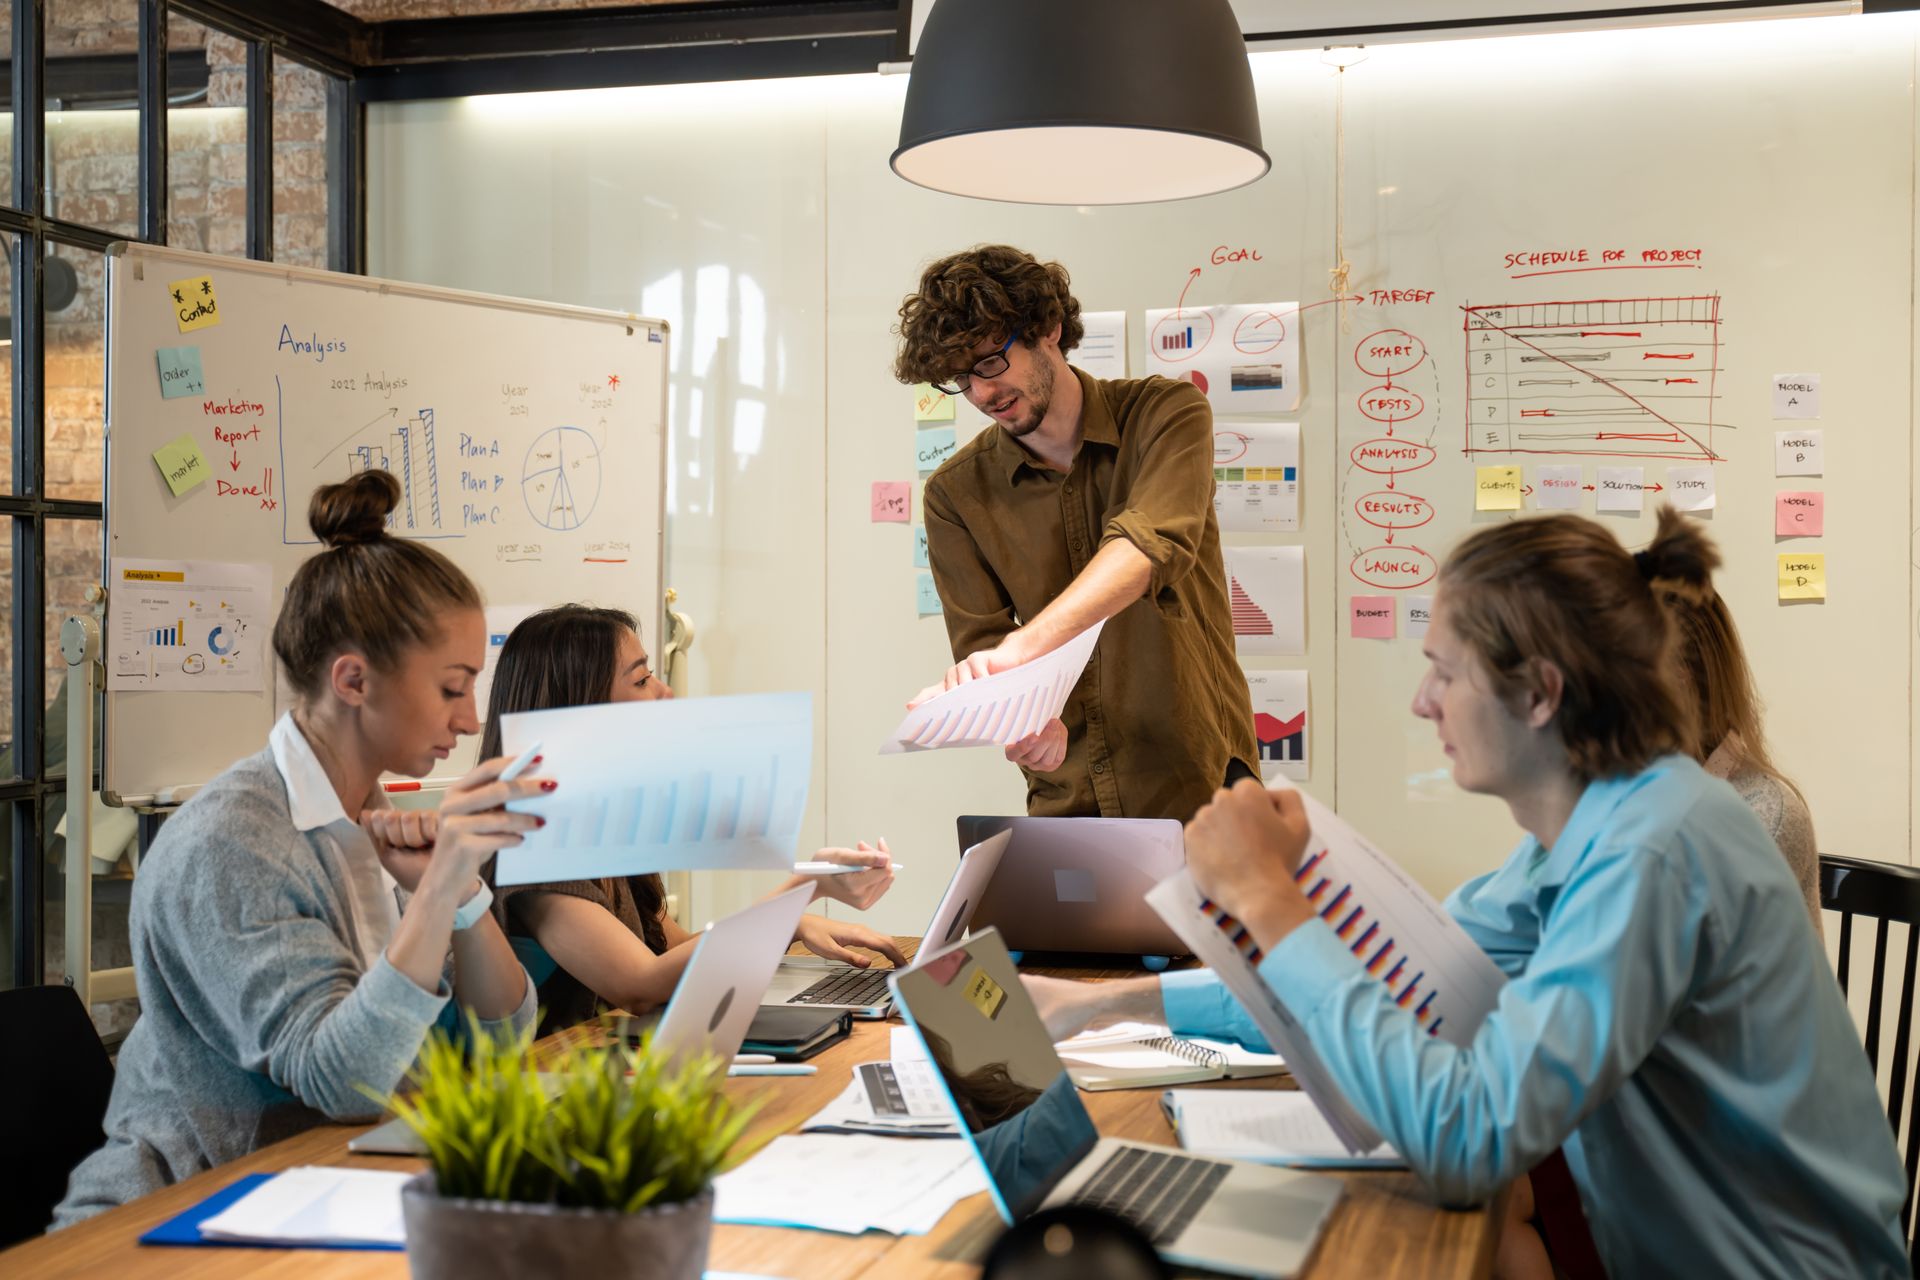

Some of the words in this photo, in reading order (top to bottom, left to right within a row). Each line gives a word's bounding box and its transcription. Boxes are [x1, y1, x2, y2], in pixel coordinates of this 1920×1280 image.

[1210, 245, 1263, 265] GOAL
[1504, 249, 1589, 269] SCHEDULE
[1602, 249, 1626, 263] FOR
[1369, 289, 1435, 305] TARGET
[180, 299, 216, 322] Contact
[278, 324, 347, 362] Analysis
[1482, 332, 1491, 344] A
[1370, 346, 1412, 358] START
[330, 378, 356, 391] 2022
[364, 370, 408, 400] Analysis
[1485, 377, 1496, 389] C
[1778, 383, 1814, 392] MODEL
[203, 398, 265, 417] Marketing
[1366, 399, 1412, 411] TESTS
[1787, 397, 1798, 407] A
[214, 424, 261, 447] Report
[459, 432, 487, 457] Plan
[489, 439, 500, 457] A
[1782, 439, 1816, 448] MODEL
[1359, 447, 1419, 460] ANALYSIS
[1796, 452, 1806, 463] B
[461, 472, 487, 492] Plan
[1480, 481, 1516, 490] CLIENTS
[1542, 480, 1578, 488] DESIGN
[1602, 479, 1644, 490] SOLUTION
[1364, 500, 1422, 515] RESULTS
[1784, 498, 1815, 506] MODEL
[463, 503, 486, 529] Plan
[490, 505, 501, 525] C
[1795, 513, 1805, 521] C
[1365, 558, 1420, 575] LAUNCH
[1785, 563, 1817, 571] MODEL
[126, 572, 154, 580] Analysis
[1796, 576, 1808, 587] D
